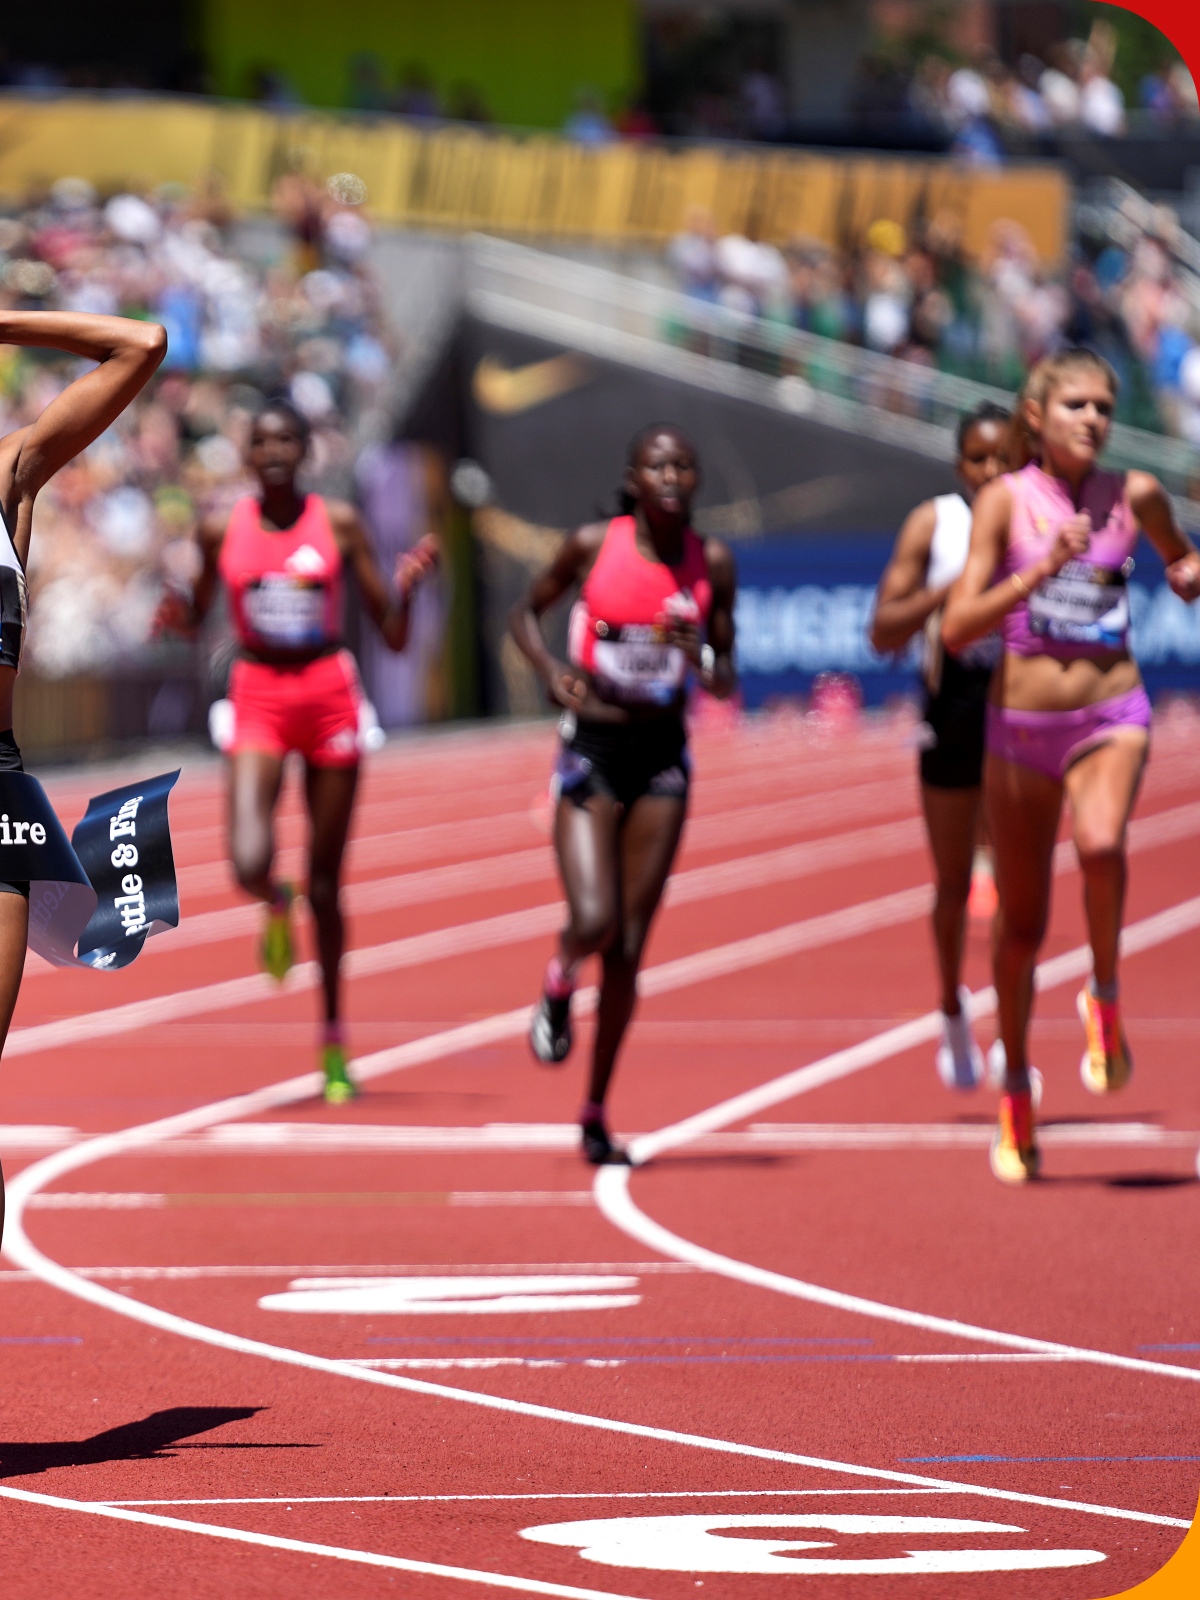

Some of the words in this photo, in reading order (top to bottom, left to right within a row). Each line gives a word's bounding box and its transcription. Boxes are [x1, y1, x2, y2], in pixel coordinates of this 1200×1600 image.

[111, 843, 138, 869] &
[114, 873, 146, 937] ettle
[520, 1513, 1109, 1574] 3
